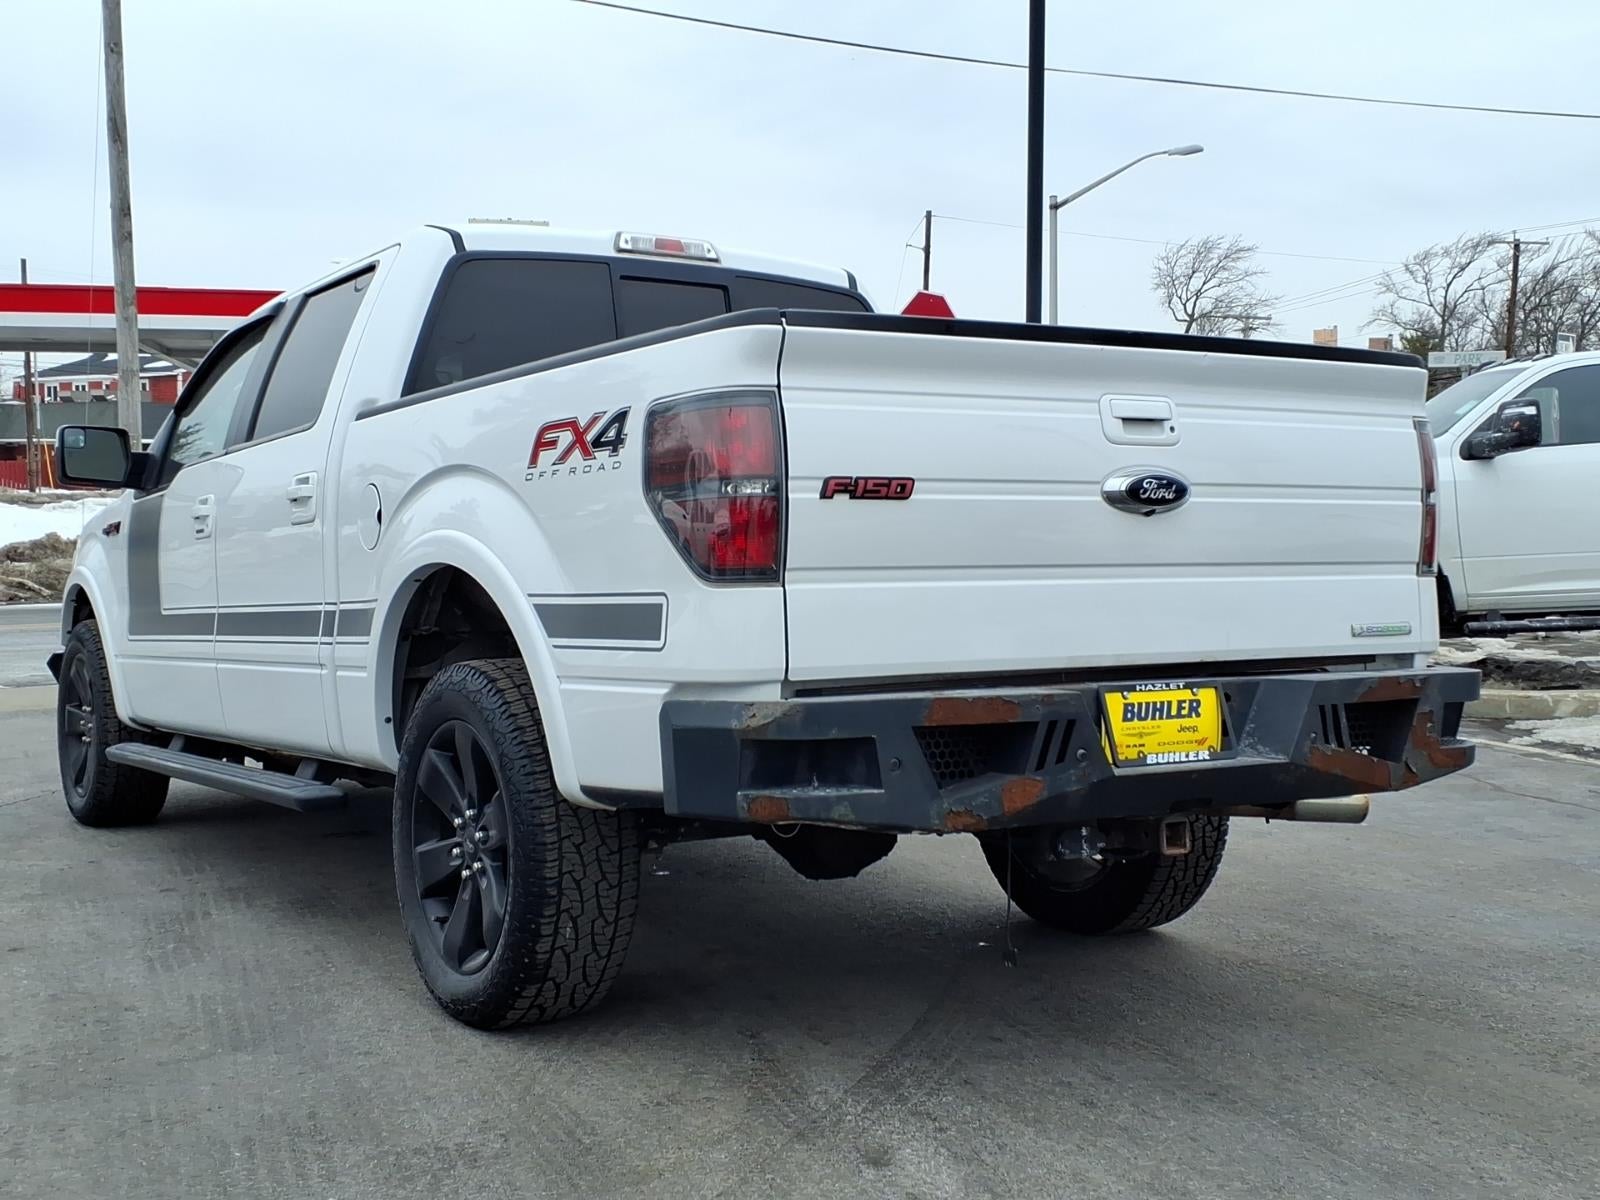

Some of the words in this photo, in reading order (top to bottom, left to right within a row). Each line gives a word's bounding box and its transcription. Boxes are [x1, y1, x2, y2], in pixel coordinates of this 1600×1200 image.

[1454, 353, 1483, 364] PARK
[527, 405, 632, 470] FX4
[525, 469, 560, 482] OFF
[568, 460, 622, 476] ROAD
[819, 476, 915, 500] F-150
[1139, 478, 1177, 500] Ford
[1136, 682, 1186, 691] HAZLET
[1121, 698, 1202, 723] BUHLER
[1176, 724, 1199, 734] Jeep
[1146, 750, 1211, 765] BUHLER
